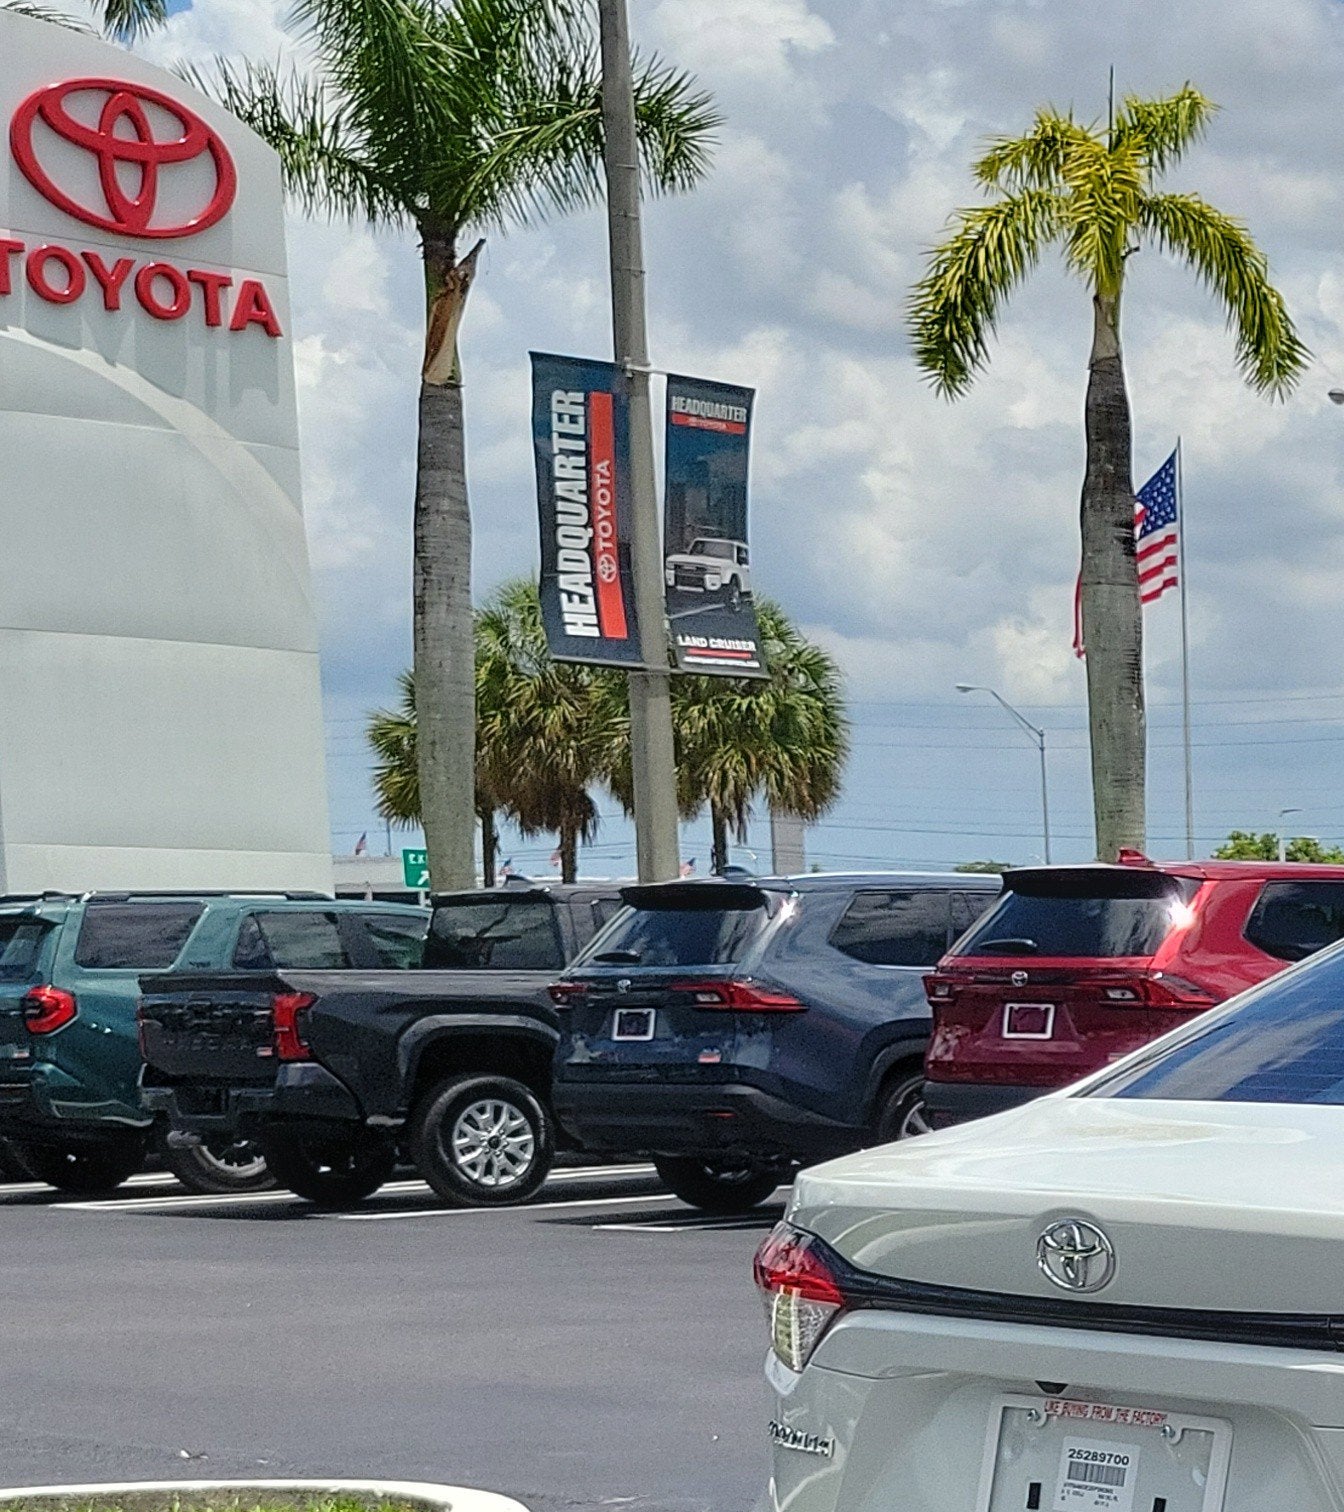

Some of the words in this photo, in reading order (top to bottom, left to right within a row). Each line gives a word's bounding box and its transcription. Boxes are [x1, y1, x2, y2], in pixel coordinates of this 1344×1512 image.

[0, 238, 283, 337] TOYOTA
[672, 395, 747, 422] HEADQUARTER
[551, 389, 600, 637] HEADQUARTER
[596, 459, 614, 550] TOYOTA
[677, 635, 708, 648] LAND
[709, 638, 757, 652] CRUISER
[1068, 1448, 1130, 1465] 25289700
